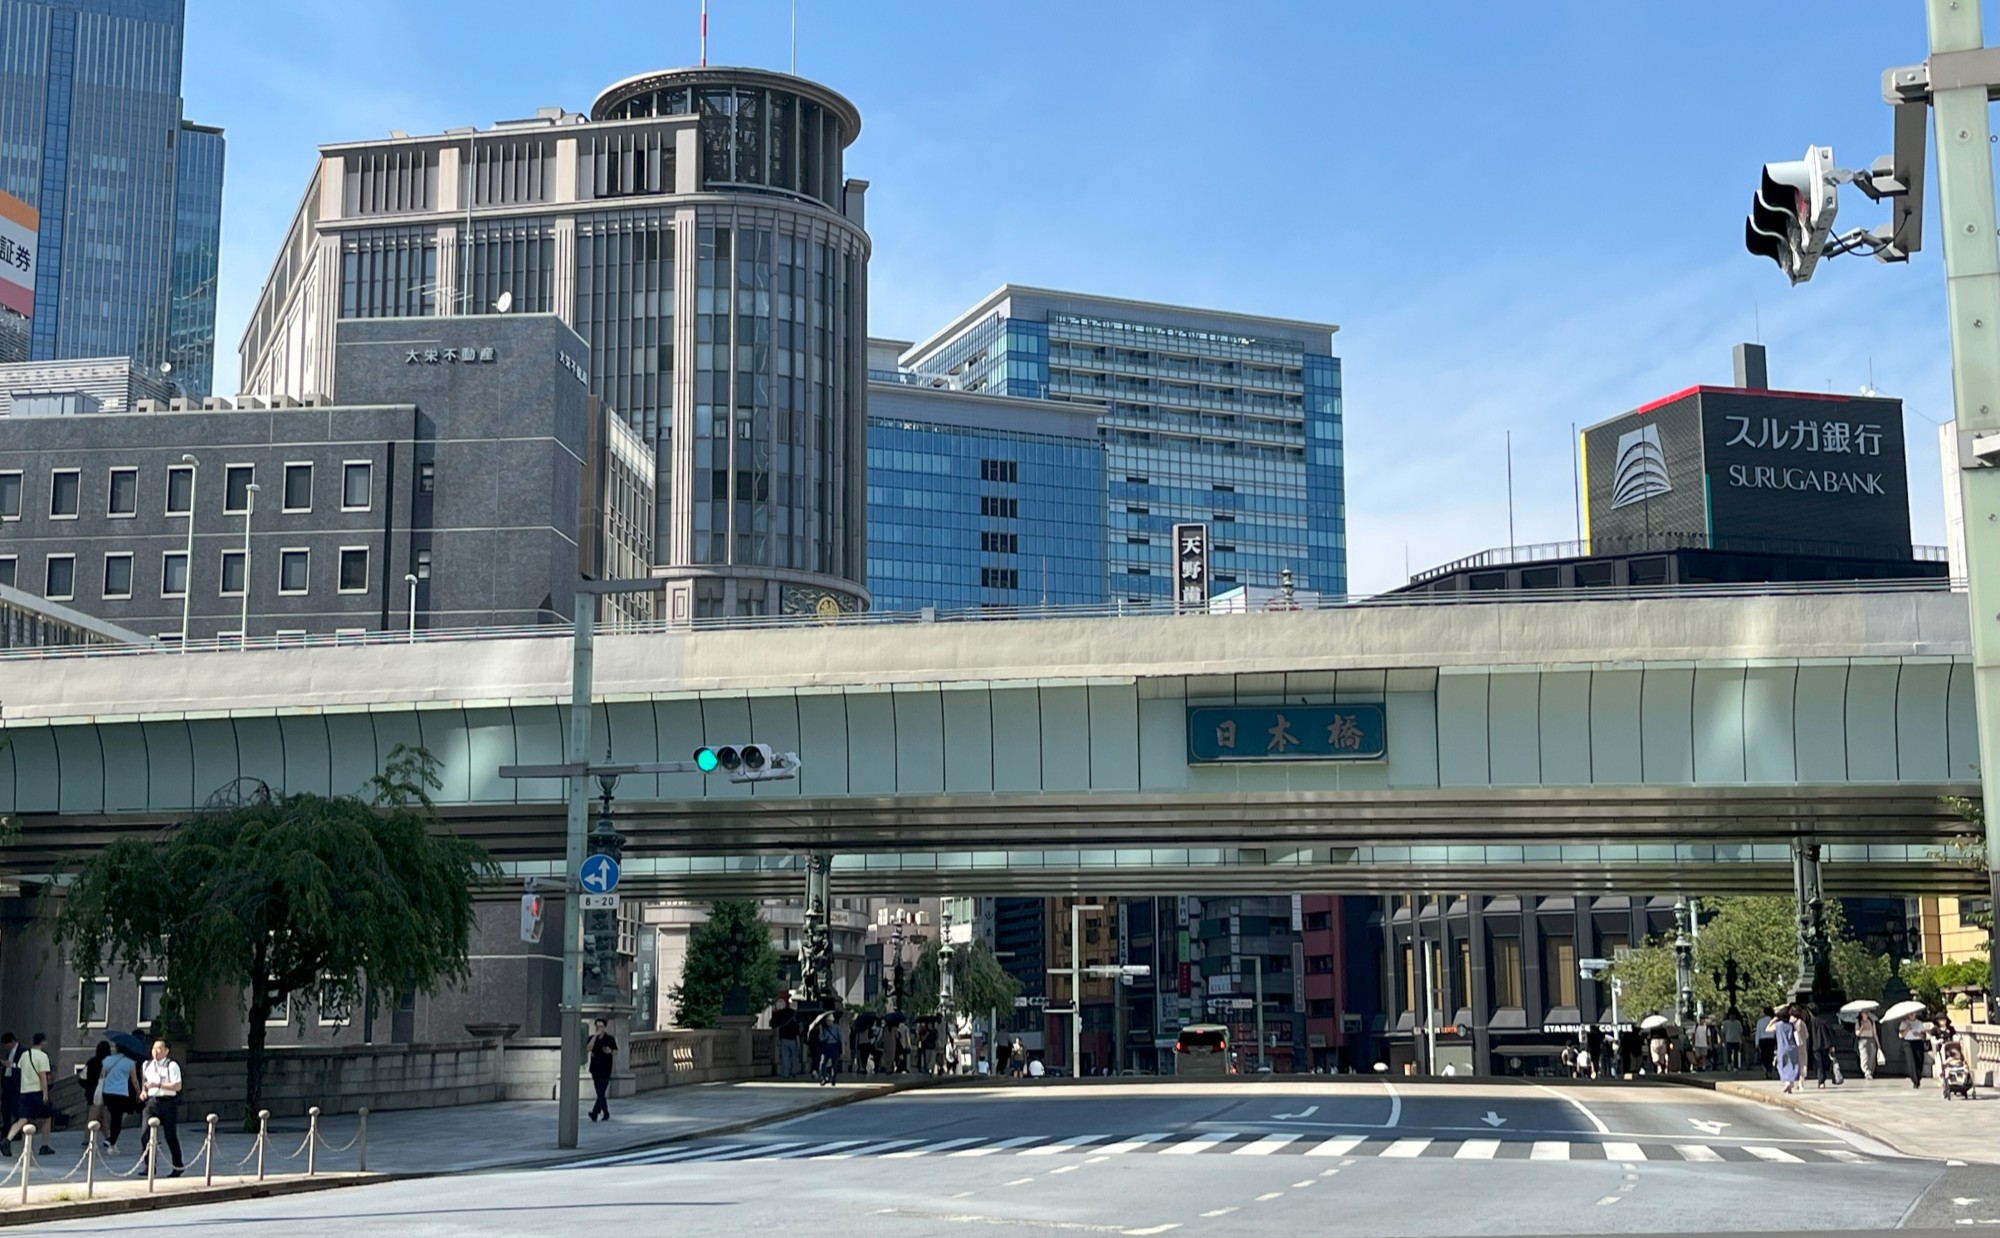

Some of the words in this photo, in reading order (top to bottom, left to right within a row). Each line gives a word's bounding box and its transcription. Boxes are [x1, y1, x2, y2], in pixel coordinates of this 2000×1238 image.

[0, 235, 31, 272] 証券
[405, 347, 494, 364] 大栄不動産
[1725, 415, 1883, 456] スルガ銀行
[1216, 713, 1365, 752] 日本橋
